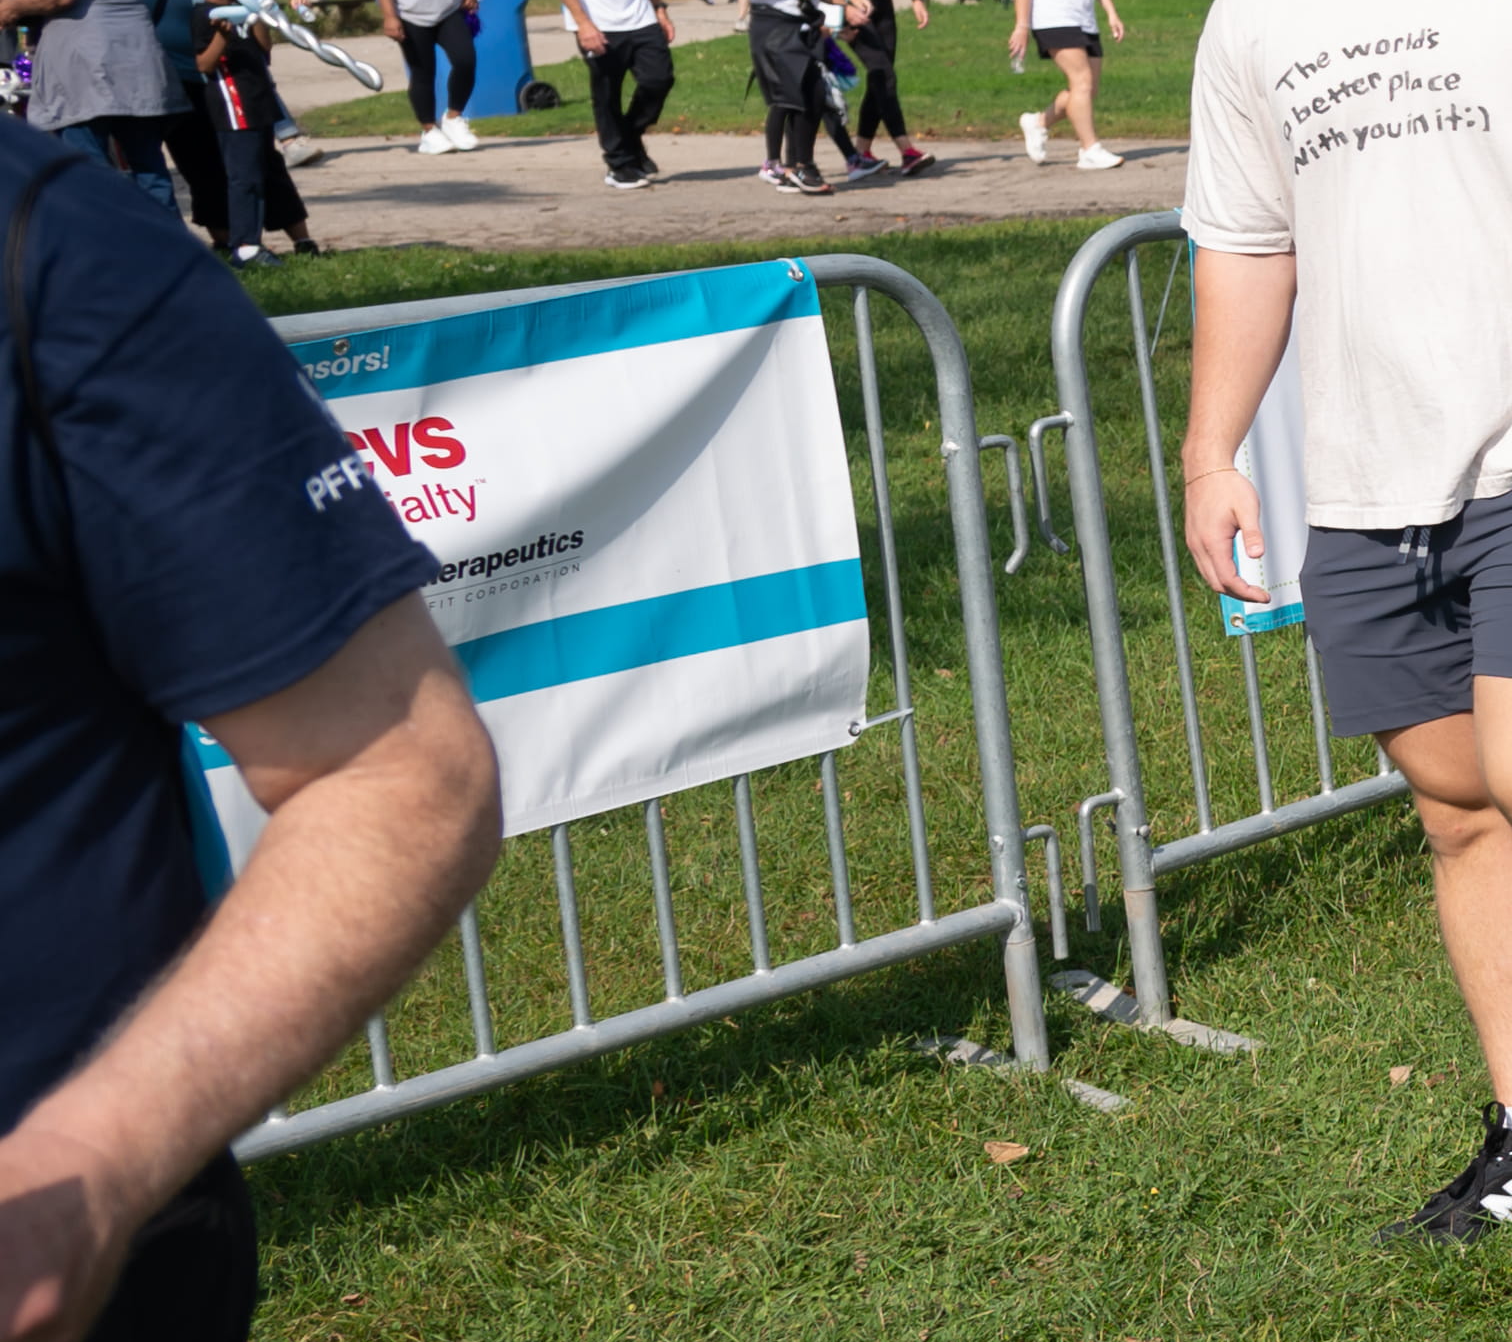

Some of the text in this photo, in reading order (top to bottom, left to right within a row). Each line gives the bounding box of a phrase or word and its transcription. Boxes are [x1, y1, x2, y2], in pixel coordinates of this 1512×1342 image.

[1275, 52, 1331, 91] The
[1291, 71, 1383, 125] better
[1388, 70, 1462, 102] place
[1353, 122, 1402, 151] you
[1407, 113, 1429, 135] in
[302, 345, 390, 380] nsors!
[384, 483, 476, 522] ialty
[421, 529, 584, 587] erapeutics
[465, 563, 581, 603] CORPORATION
